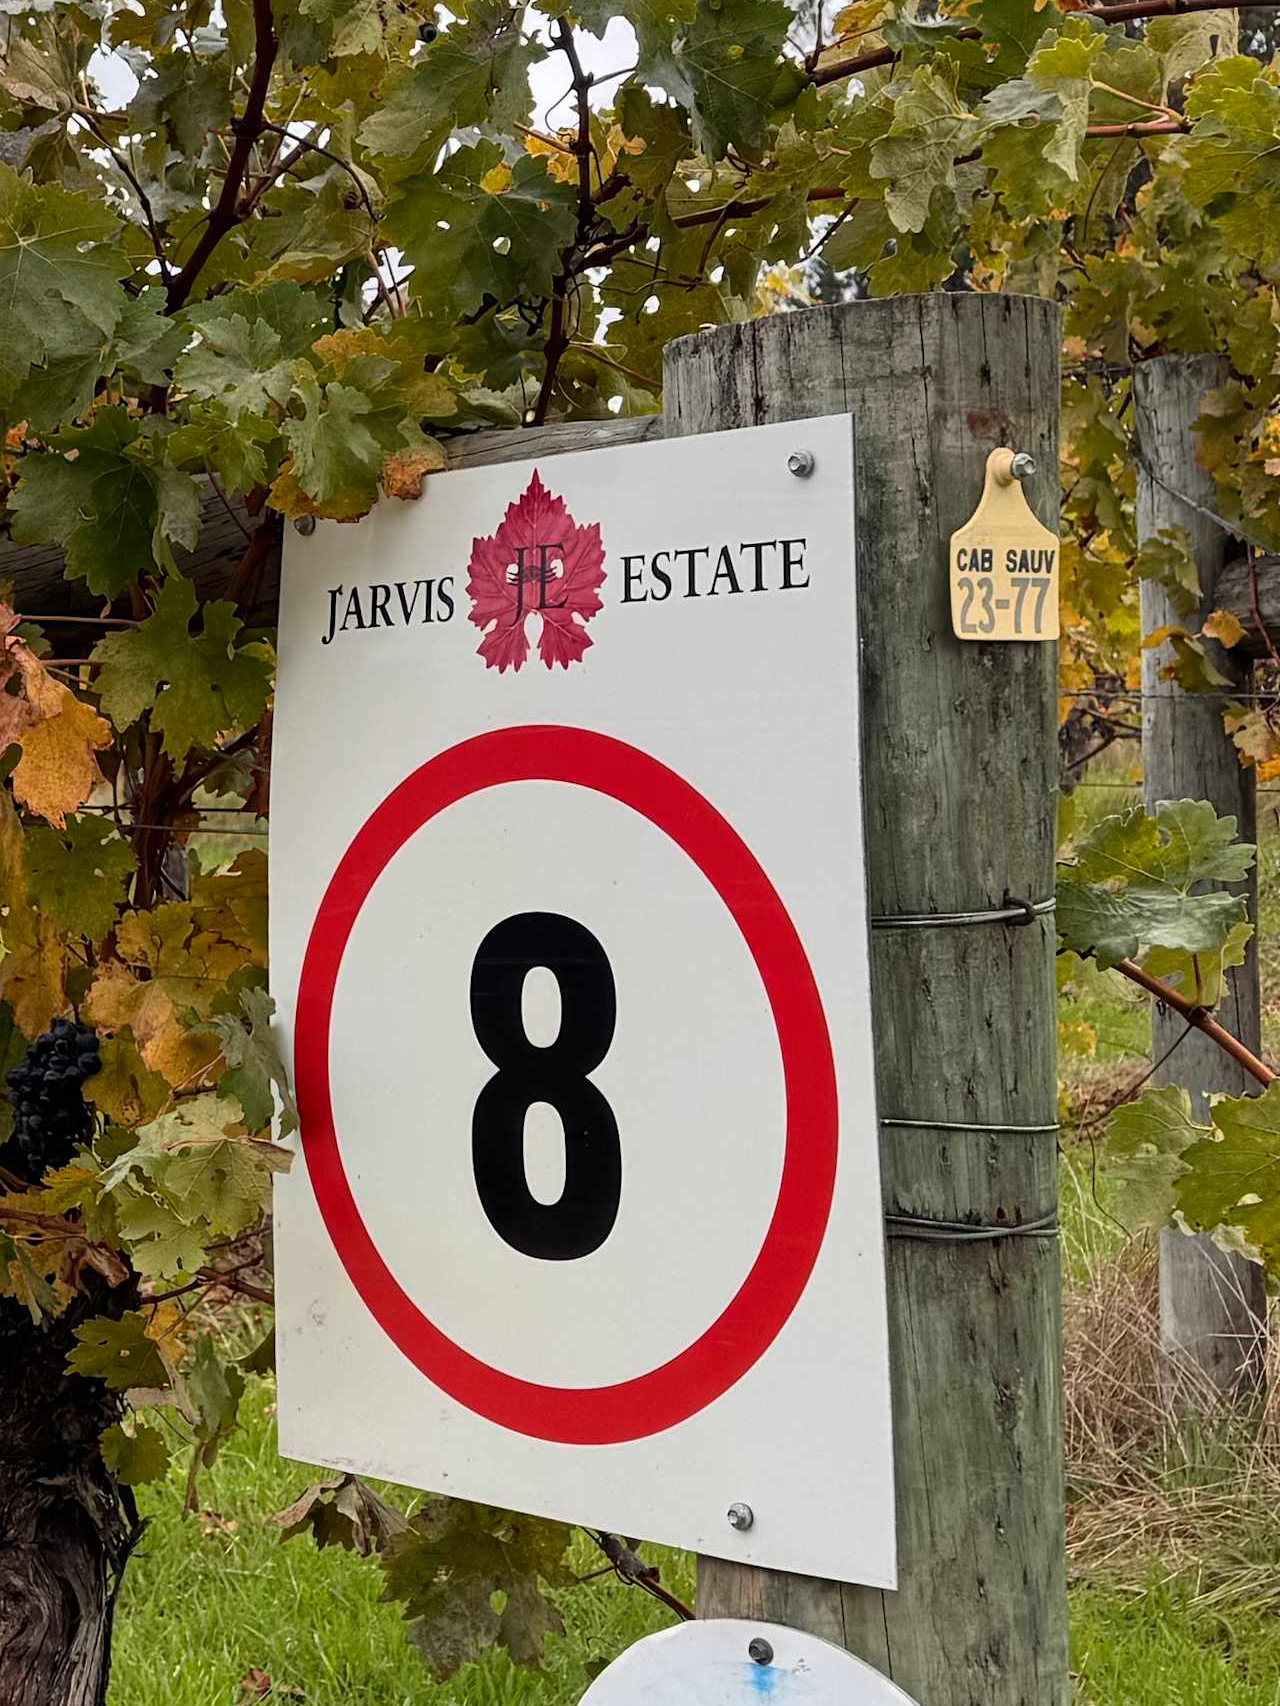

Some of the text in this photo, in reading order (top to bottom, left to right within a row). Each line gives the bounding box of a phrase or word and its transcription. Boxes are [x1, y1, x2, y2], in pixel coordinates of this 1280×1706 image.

[322, 576, 455, 644] JARVIS
[620, 538, 811, 603] ESTATE
[957, 548, 1055, 574] CAB SAUV
[958, 577, 1051, 634] 23-77
[469, 911, 622, 1260] 8
